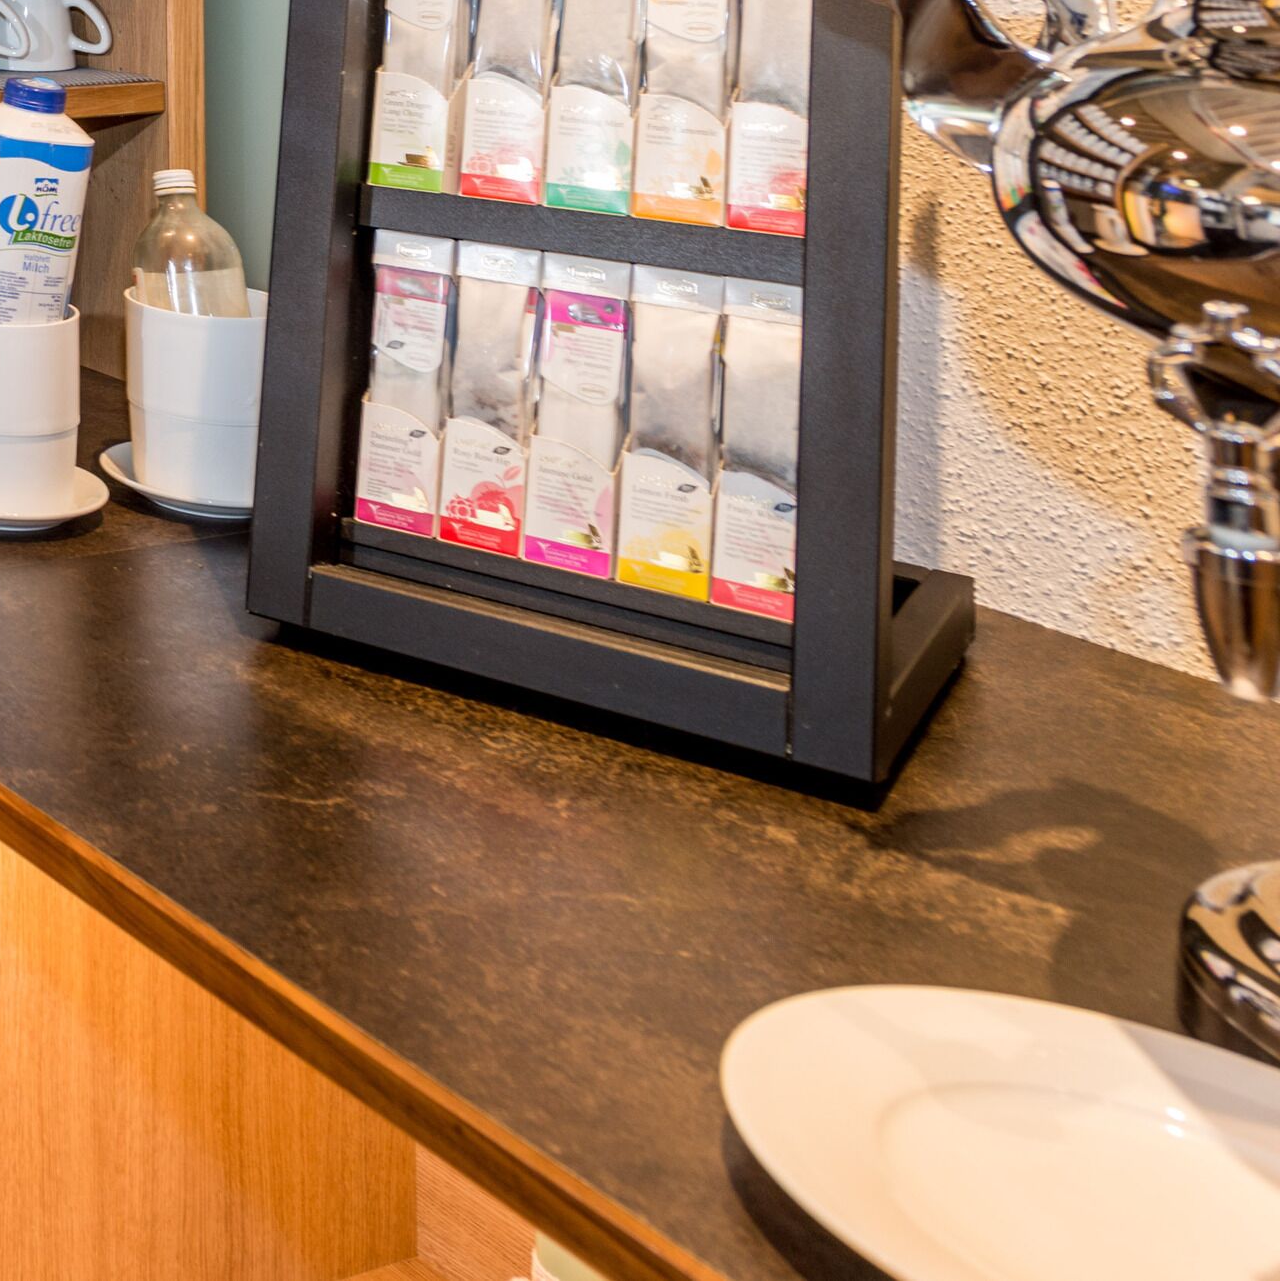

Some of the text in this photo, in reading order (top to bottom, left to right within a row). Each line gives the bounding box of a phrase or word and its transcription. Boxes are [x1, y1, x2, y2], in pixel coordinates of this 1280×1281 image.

[40, 200, 82, 233] free
[17, 230, 75, 248] Laktosefrei
[22, 262, 50, 274] Milch
